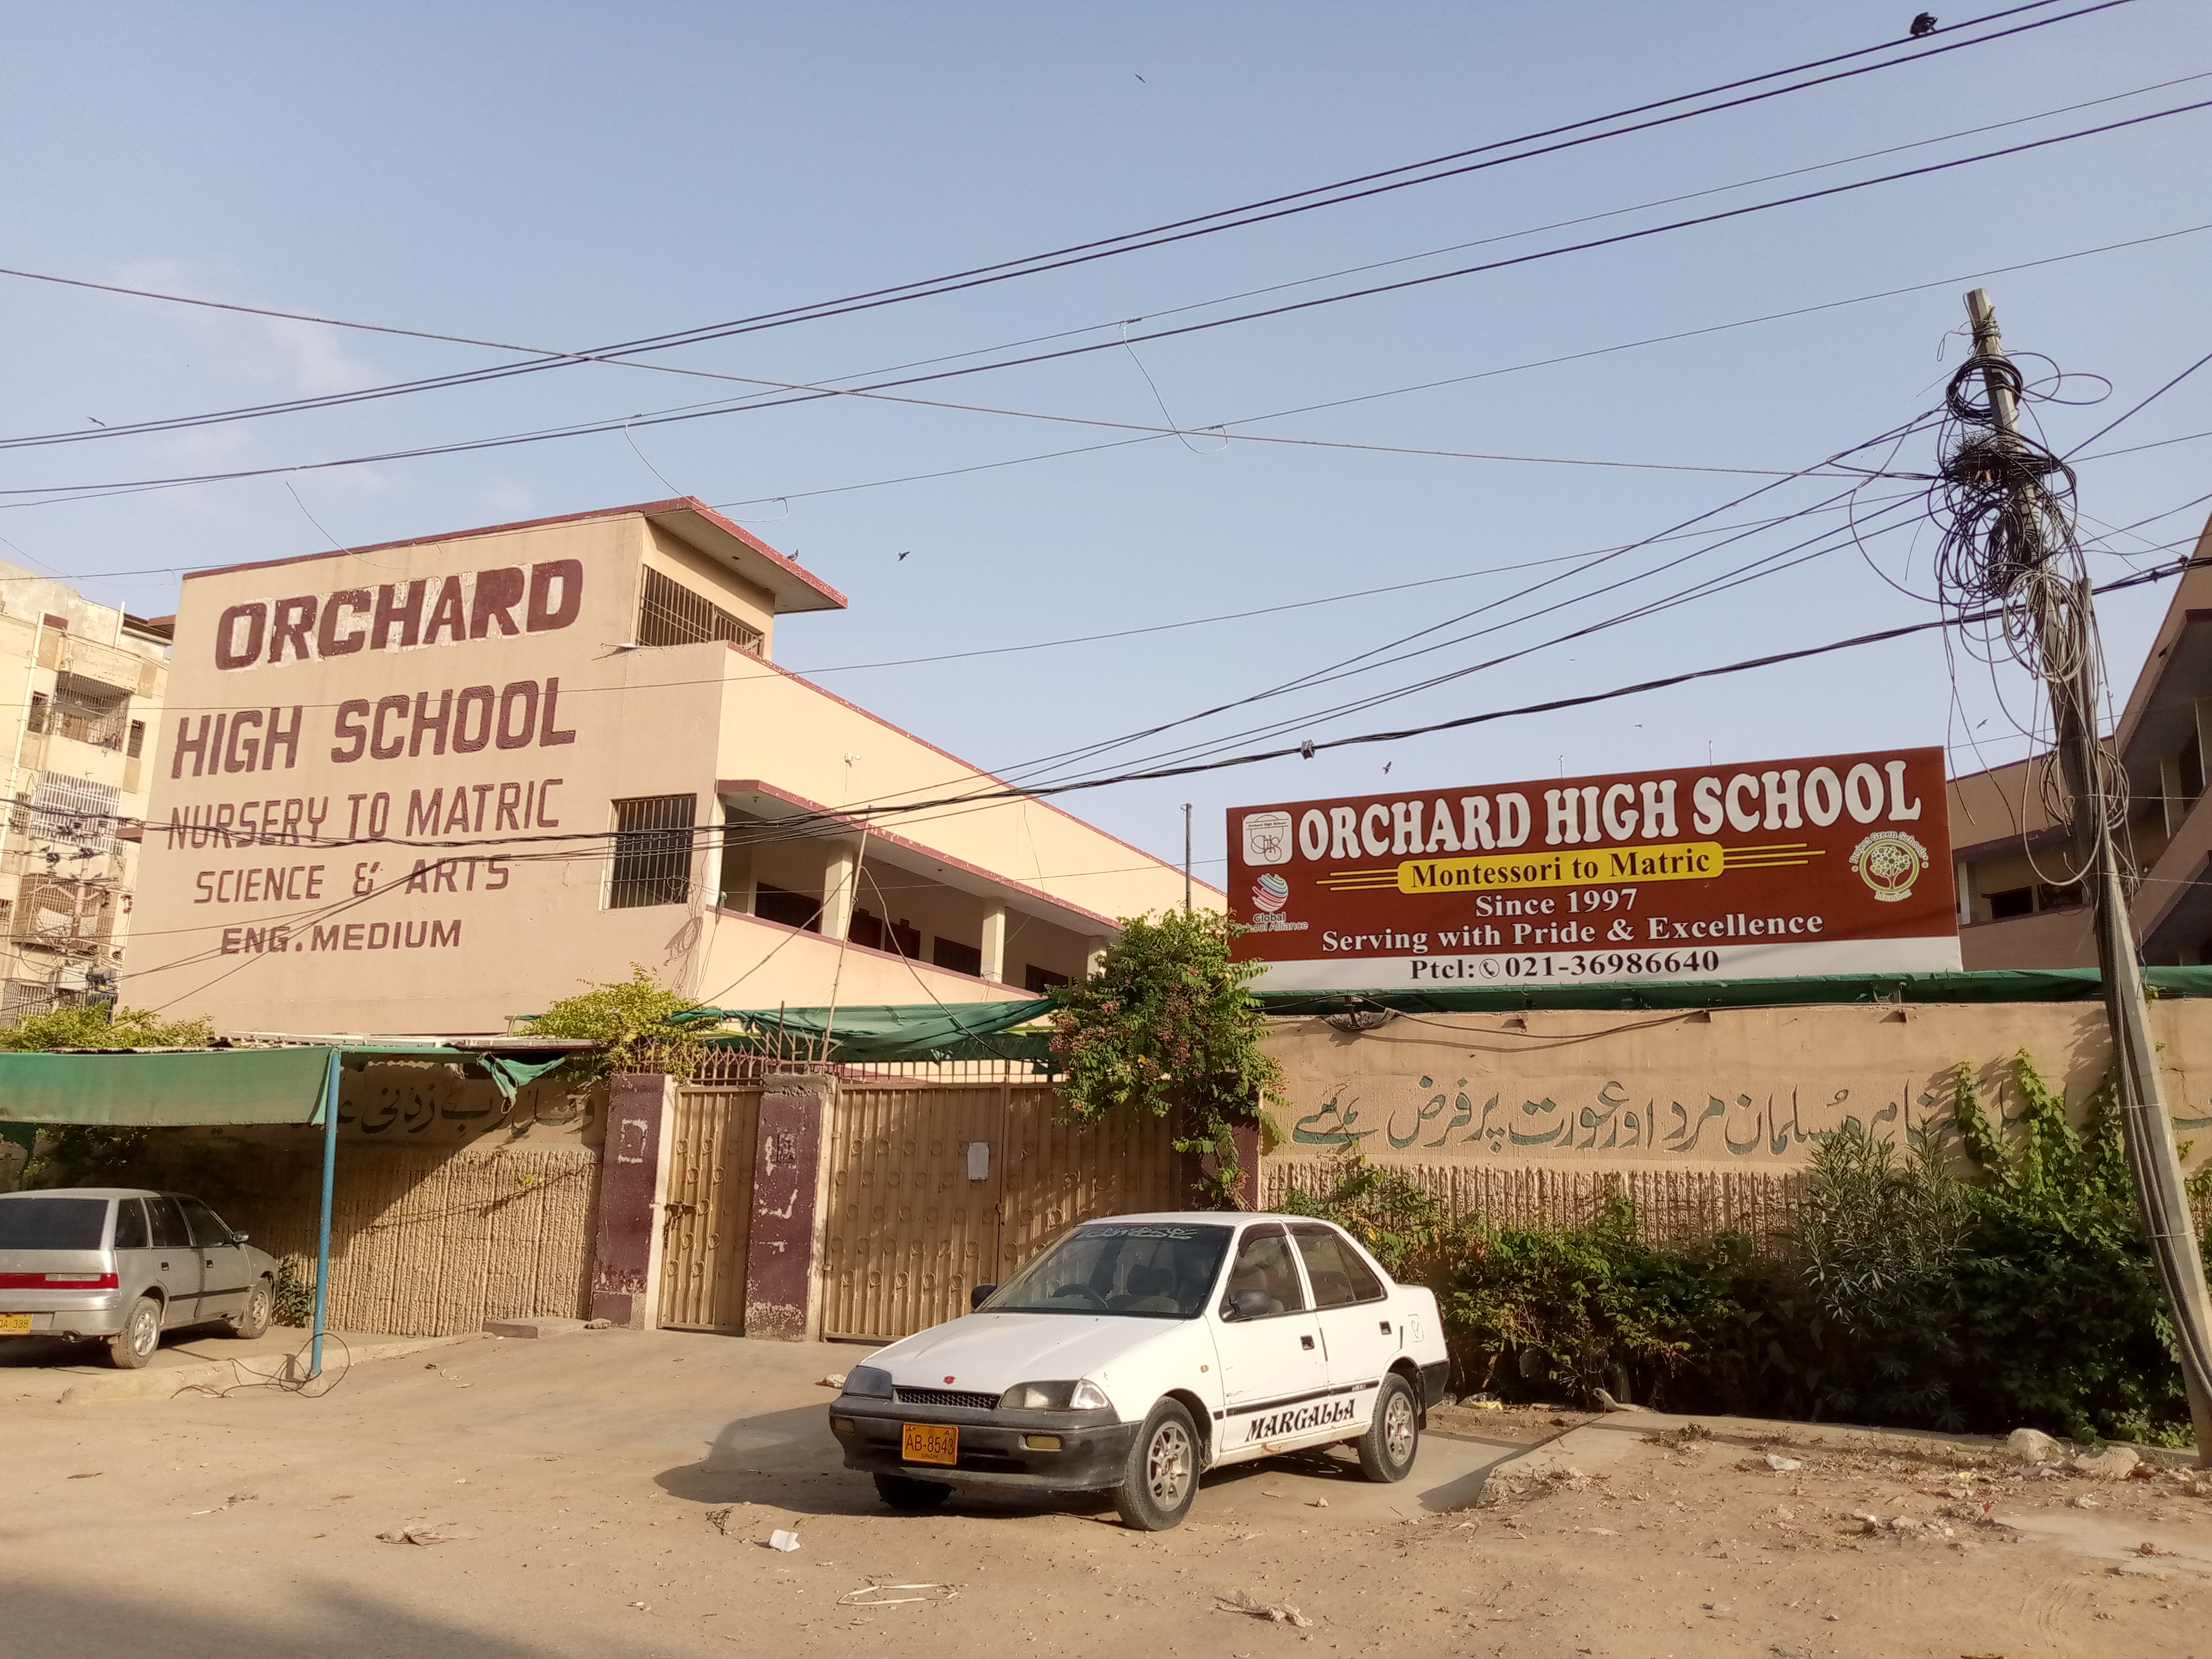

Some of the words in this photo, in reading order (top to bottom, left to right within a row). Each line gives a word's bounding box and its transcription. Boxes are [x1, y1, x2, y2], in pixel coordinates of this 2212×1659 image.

[215, 559, 583, 670] ORCHARD
[171, 706, 303, 780] HIGH
[331, 677, 576, 764] SCHOOL
[167, 797, 328, 851] NURSERY
[347, 792, 390, 841] TO
[406, 778, 564, 837] MATRIC
[1298, 792, 1531, 861] ORCHARD
[1543, 778, 1680, 845] HIGH
[1692, 759, 1922, 835] SCHOOL
[1849, 836, 1872, 864] Project
[1871, 831, 1898, 841] Green
[1898, 831, 1927, 858] Schools
[194, 865, 325, 904] SCIENCE
[352, 861, 380, 898] &
[405, 853, 510, 894] ARTS
[1410, 856, 1562, 889] Montessori
[1572, 857, 1599, 879] to
[1608, 848, 1711, 877] Matric
[1475, 894, 1555, 918] Since
[1566, 888, 1638, 914] 1997
[1874, 889, 1913, 902] Member
[1253, 911, 1286, 923] Global
[1269, 921, 1309, 932] Alliance
[1322, 927, 1429, 954] Serving
[1437, 923, 1501, 947] with
[1511, 921, 1596, 945] Pride
[1606, 918, 1635, 942] &
[1646, 912, 1824, 940] Excellence
[1410, 958, 1475, 980] Ptcl:
[1504, 949, 1720, 978] 021-36986640
[1244, 1398, 1355, 1443] MARGALLA
[906, 1434, 954, 1455] AB-8543
